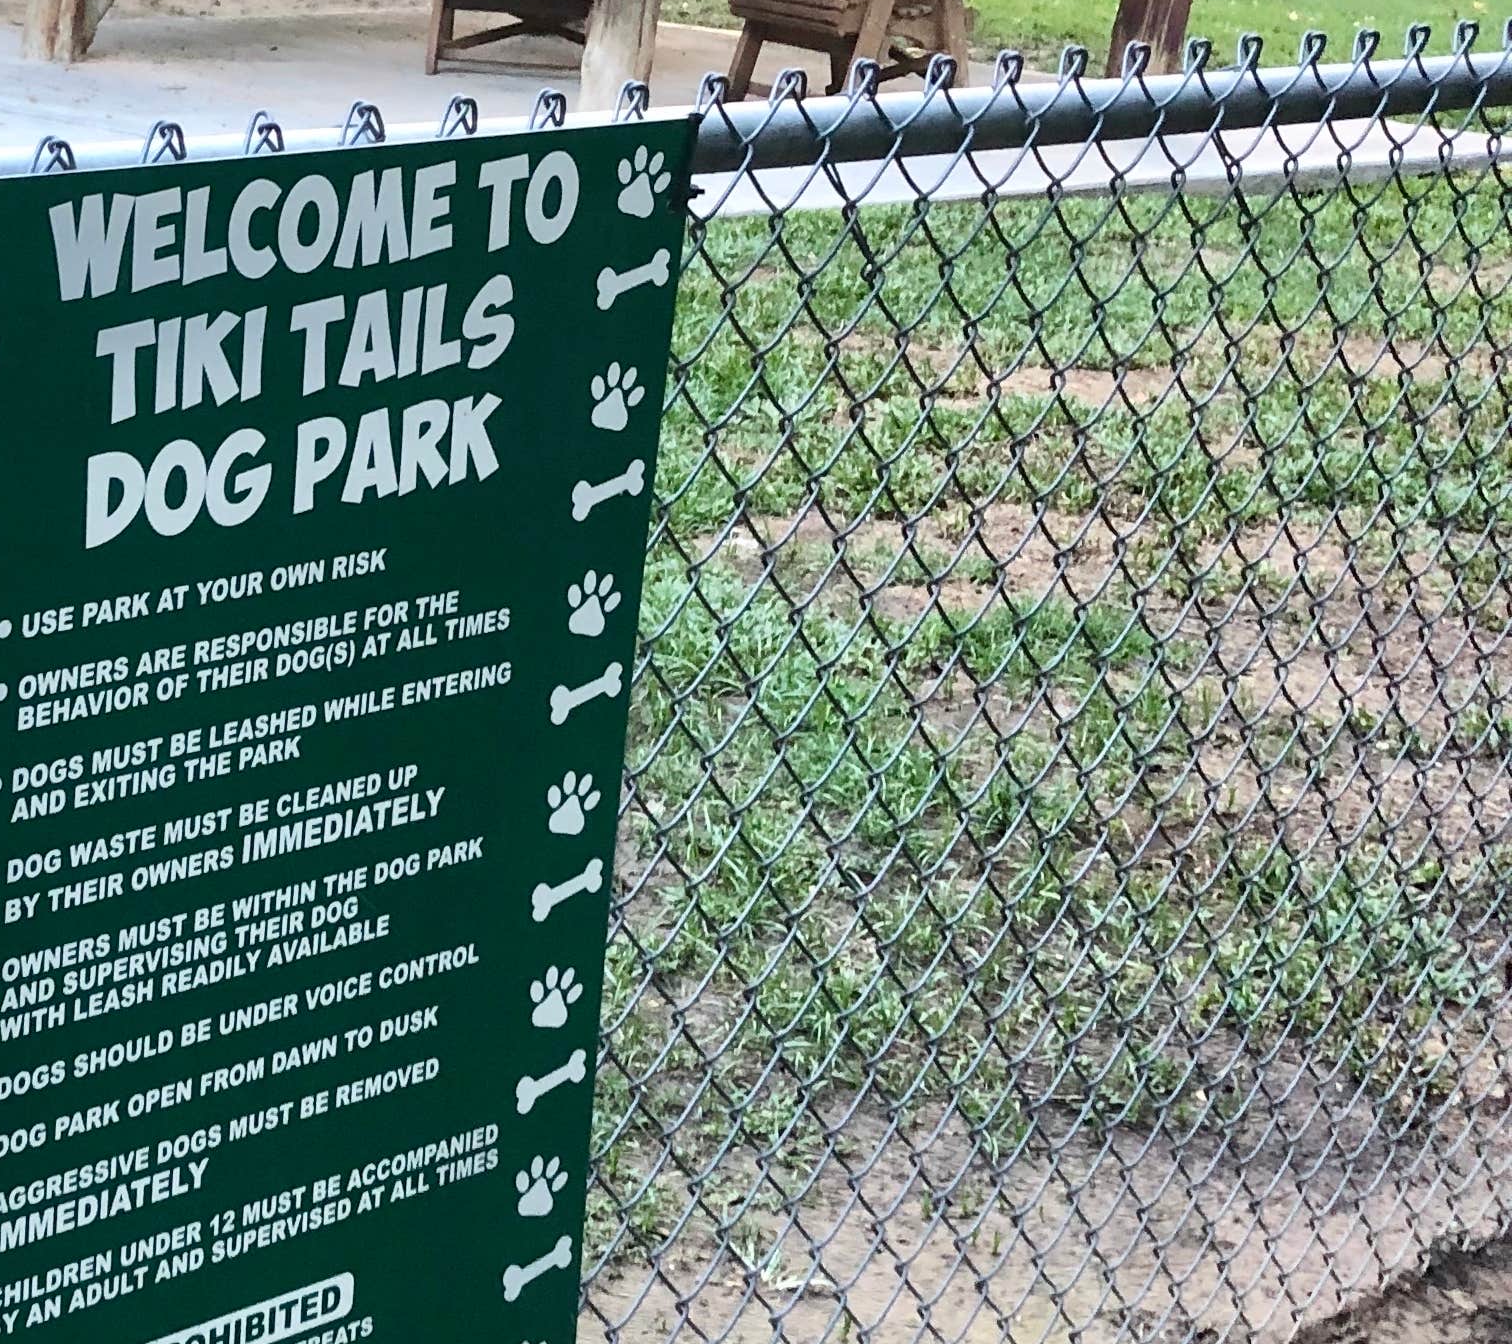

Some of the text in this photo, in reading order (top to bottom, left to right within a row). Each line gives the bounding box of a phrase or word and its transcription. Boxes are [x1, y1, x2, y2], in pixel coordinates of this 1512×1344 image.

[48, 150, 580, 302] WELCOME TO
[95, 273, 515, 425] TIKI TAILS
[84, 391, 503, 549] DOG PARK
[18, 589, 460, 700] OWNERS ARE RESPONSIBLE FOR THE
[21, 547, 387, 638] USE PARK AT YOUR OWN RISK
[11, 661, 512, 793] DOGS MUST BE LEASHED WHILE ENTERING
[17, 607, 510, 731] BEHAVIOR OF THEIR DOG(S) AT ALL TIMES
[6, 764, 418, 884] DOG WASTE MUST BE CLEANED UP
[10, 734, 302, 823] AND EXITING THE PARK
[1, 836, 483, 982] OWNERS MUST BE WITHIN THE DOG PARK
[4, 786, 446, 924] BY THEIR OWNERS IMMEDIATELY
[0, 895, 359, 1013] AND SUPERVISING THEIR DOG
[0, 913, 390, 1042] WITH LEASH READILY AVAILABLE
[73, 1029, 174, 1078] SHOULD
[180, 1017, 212, 1047] BE
[218, 993, 298, 1035] UNDER
[304, 971, 373, 1010] VOICE
[378, 942, 480, 989] CONTROL
[54, 1099, 120, 1141] PARK
[127, 1077, 193, 1118] OPEN
[199, 1056, 265, 1097] FROM
[271, 1034, 338, 1075] DAWN
[343, 1025, 374, 1052] TO
[379, 1004, 439, 1043] DUSK
[156, 1123, 222, 1165] DOGS
[228, 1101, 294, 1142] MUST
[299, 1089, 329, 1119] BE
[335, 1057, 439, 1108] REMOVED
[25, 1294, 62, 1328] AN
[67, 1265, 149, 1313] ADULT
[154, 1247, 205, 1284] AND
[210, 1197, 352, 1263] SUPERVISED
[356, 1184, 386, 1214] AT
[389, 1171, 430, 1203] ALL
[435, 1147, 498, 1186] TIMES
[119, 1220, 201, 1267] UNDER
[209, 1209, 235, 1237] 12
[241, 1185, 307, 1227] MUST
[312, 1173, 341, 1204] BE
[346, 1123, 499, 1192] ACCOMPANIED
